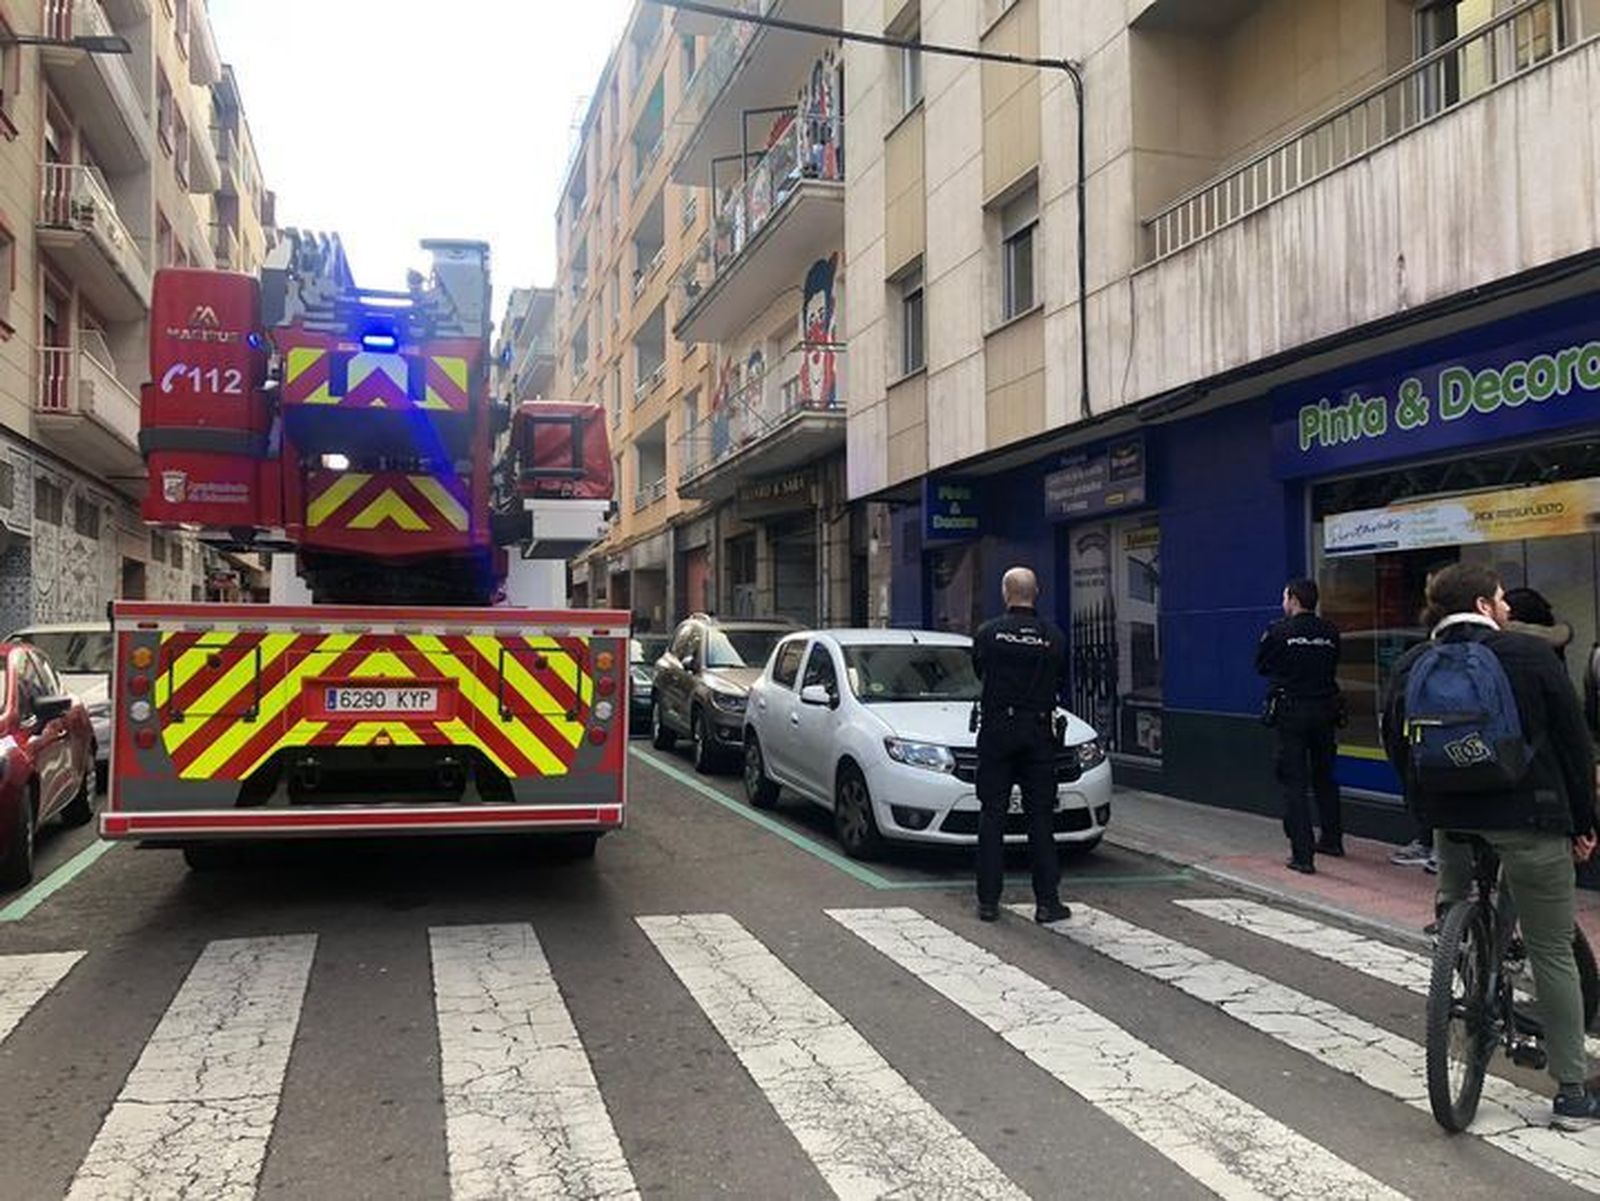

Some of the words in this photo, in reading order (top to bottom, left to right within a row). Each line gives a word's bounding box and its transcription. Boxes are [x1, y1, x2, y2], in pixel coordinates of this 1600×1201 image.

[187, 367, 242, 394] 112
[1299, 392, 1386, 451] Pinta
[1395, 377, 1428, 430] &
[339, 691, 387, 709] 6290
[396, 692, 432, 708] KYP
